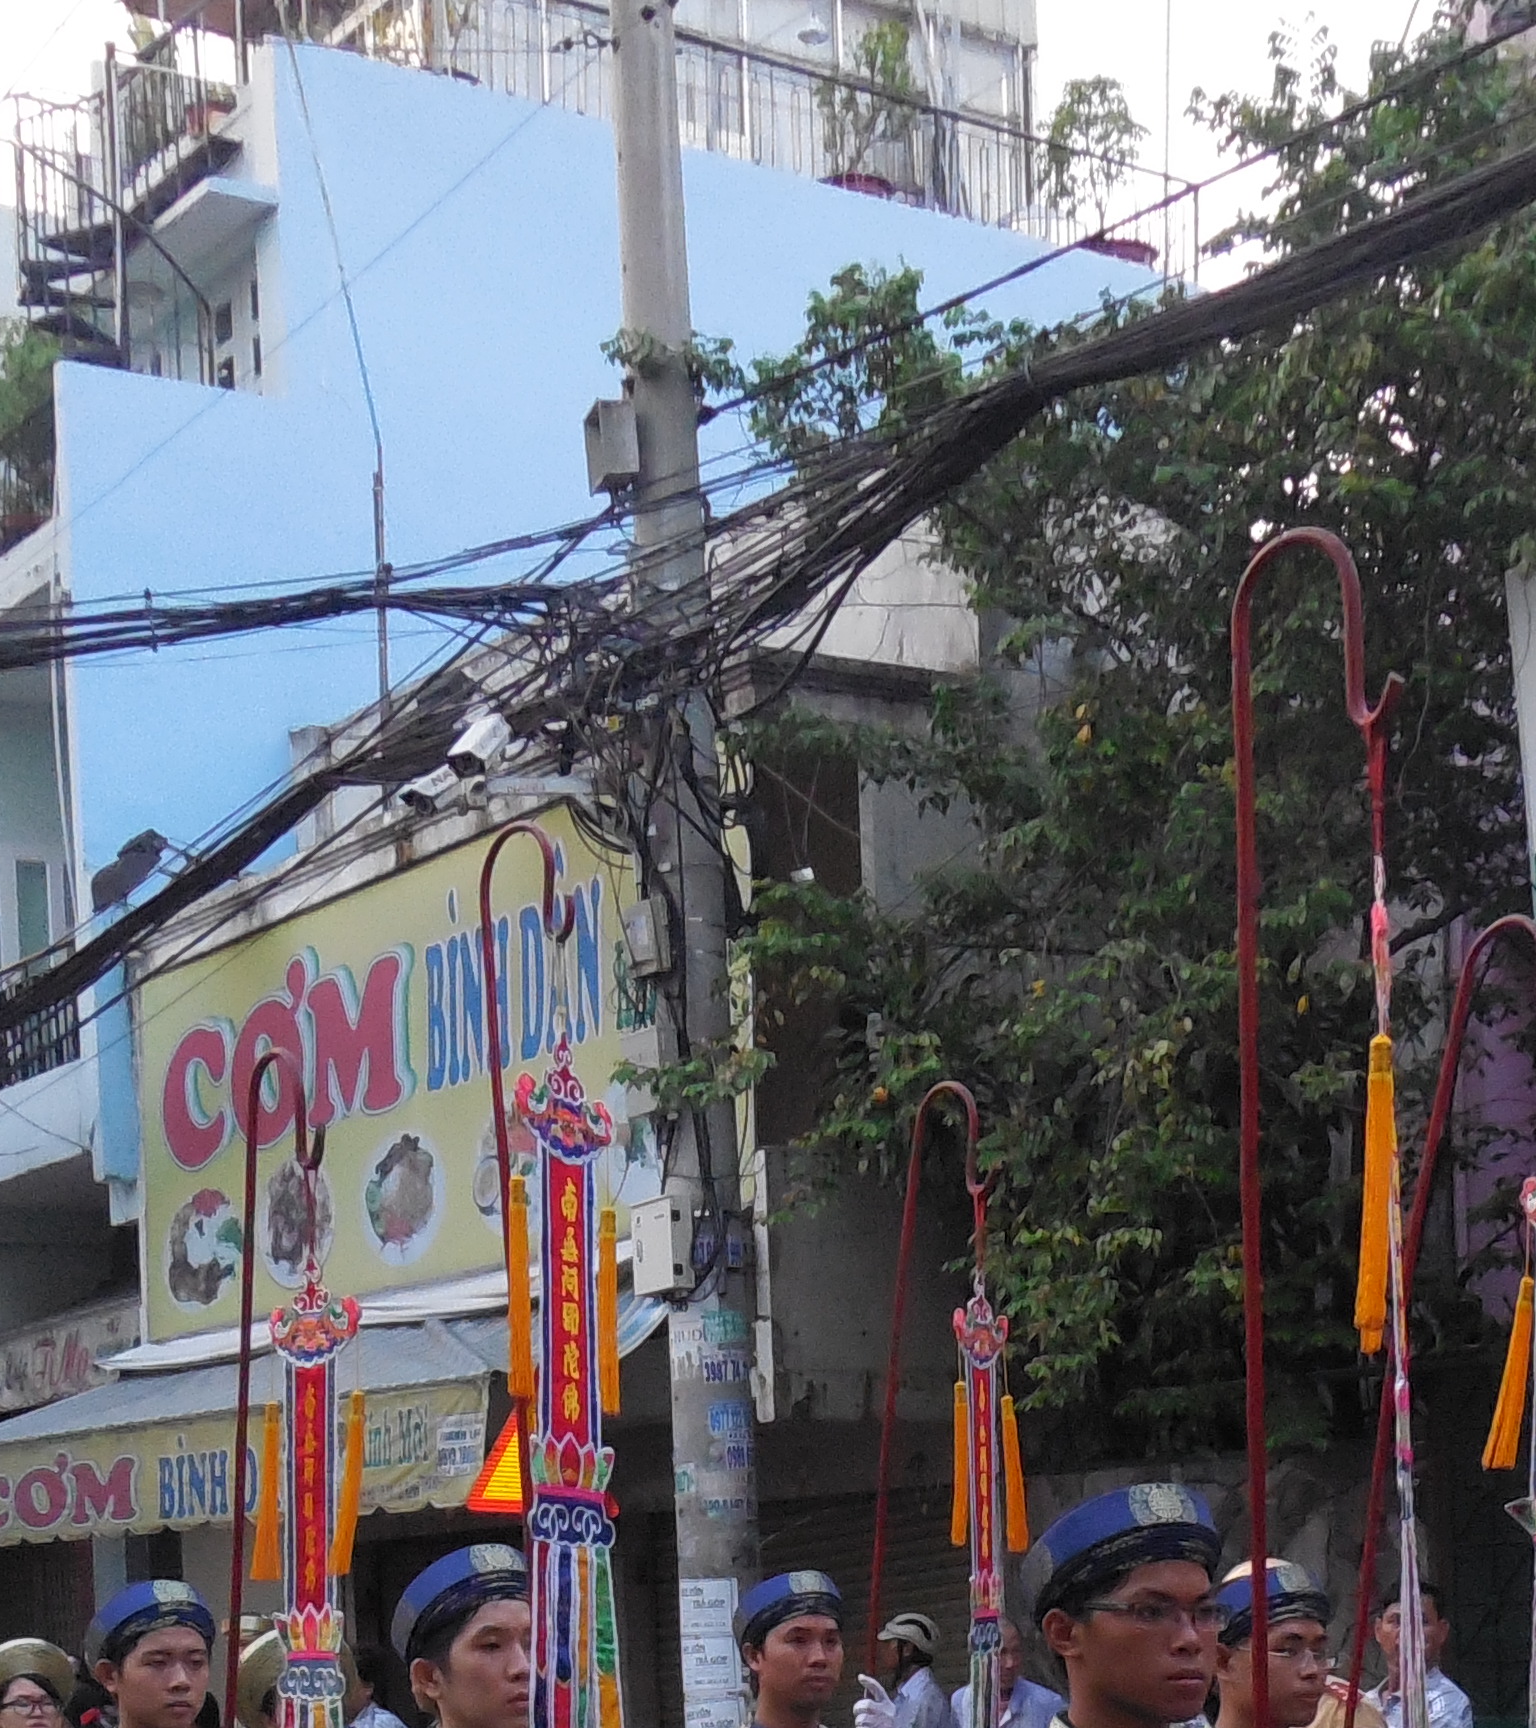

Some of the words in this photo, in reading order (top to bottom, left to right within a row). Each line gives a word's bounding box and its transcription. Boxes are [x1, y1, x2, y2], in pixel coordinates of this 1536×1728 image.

[163, 950, 408, 1169] CƠM
[425, 888, 510, 1092] BÌNH
[158, 1434, 229, 1520] BÌNH
